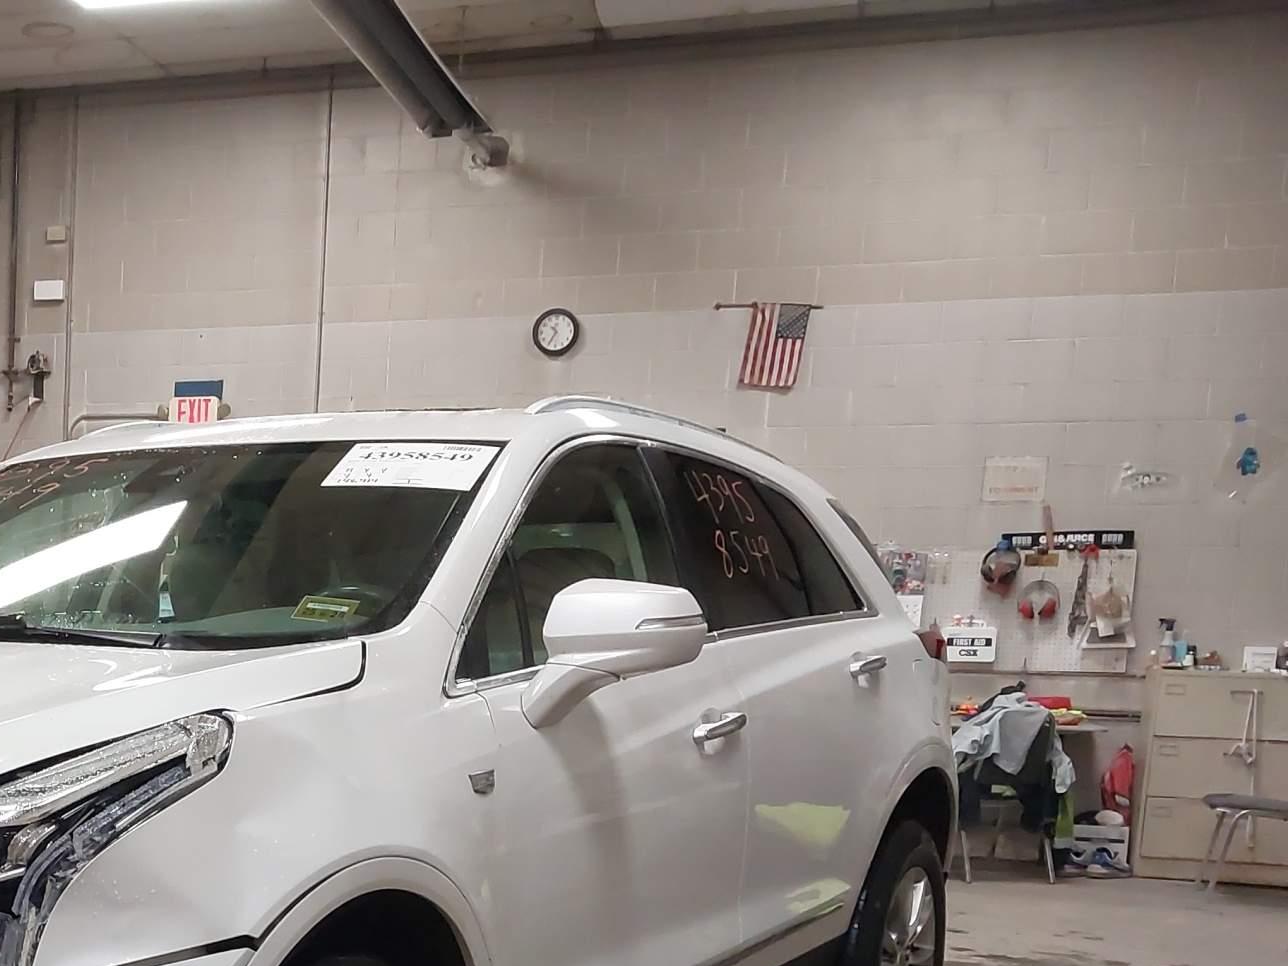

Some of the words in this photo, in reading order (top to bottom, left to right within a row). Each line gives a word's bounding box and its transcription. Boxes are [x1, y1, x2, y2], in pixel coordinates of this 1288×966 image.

[177, 399, 211, 423] EXIT
[359, 451, 473, 461] 43958549
[683, 471, 755, 524] 4395
[715, 530, 779, 580] 8549
